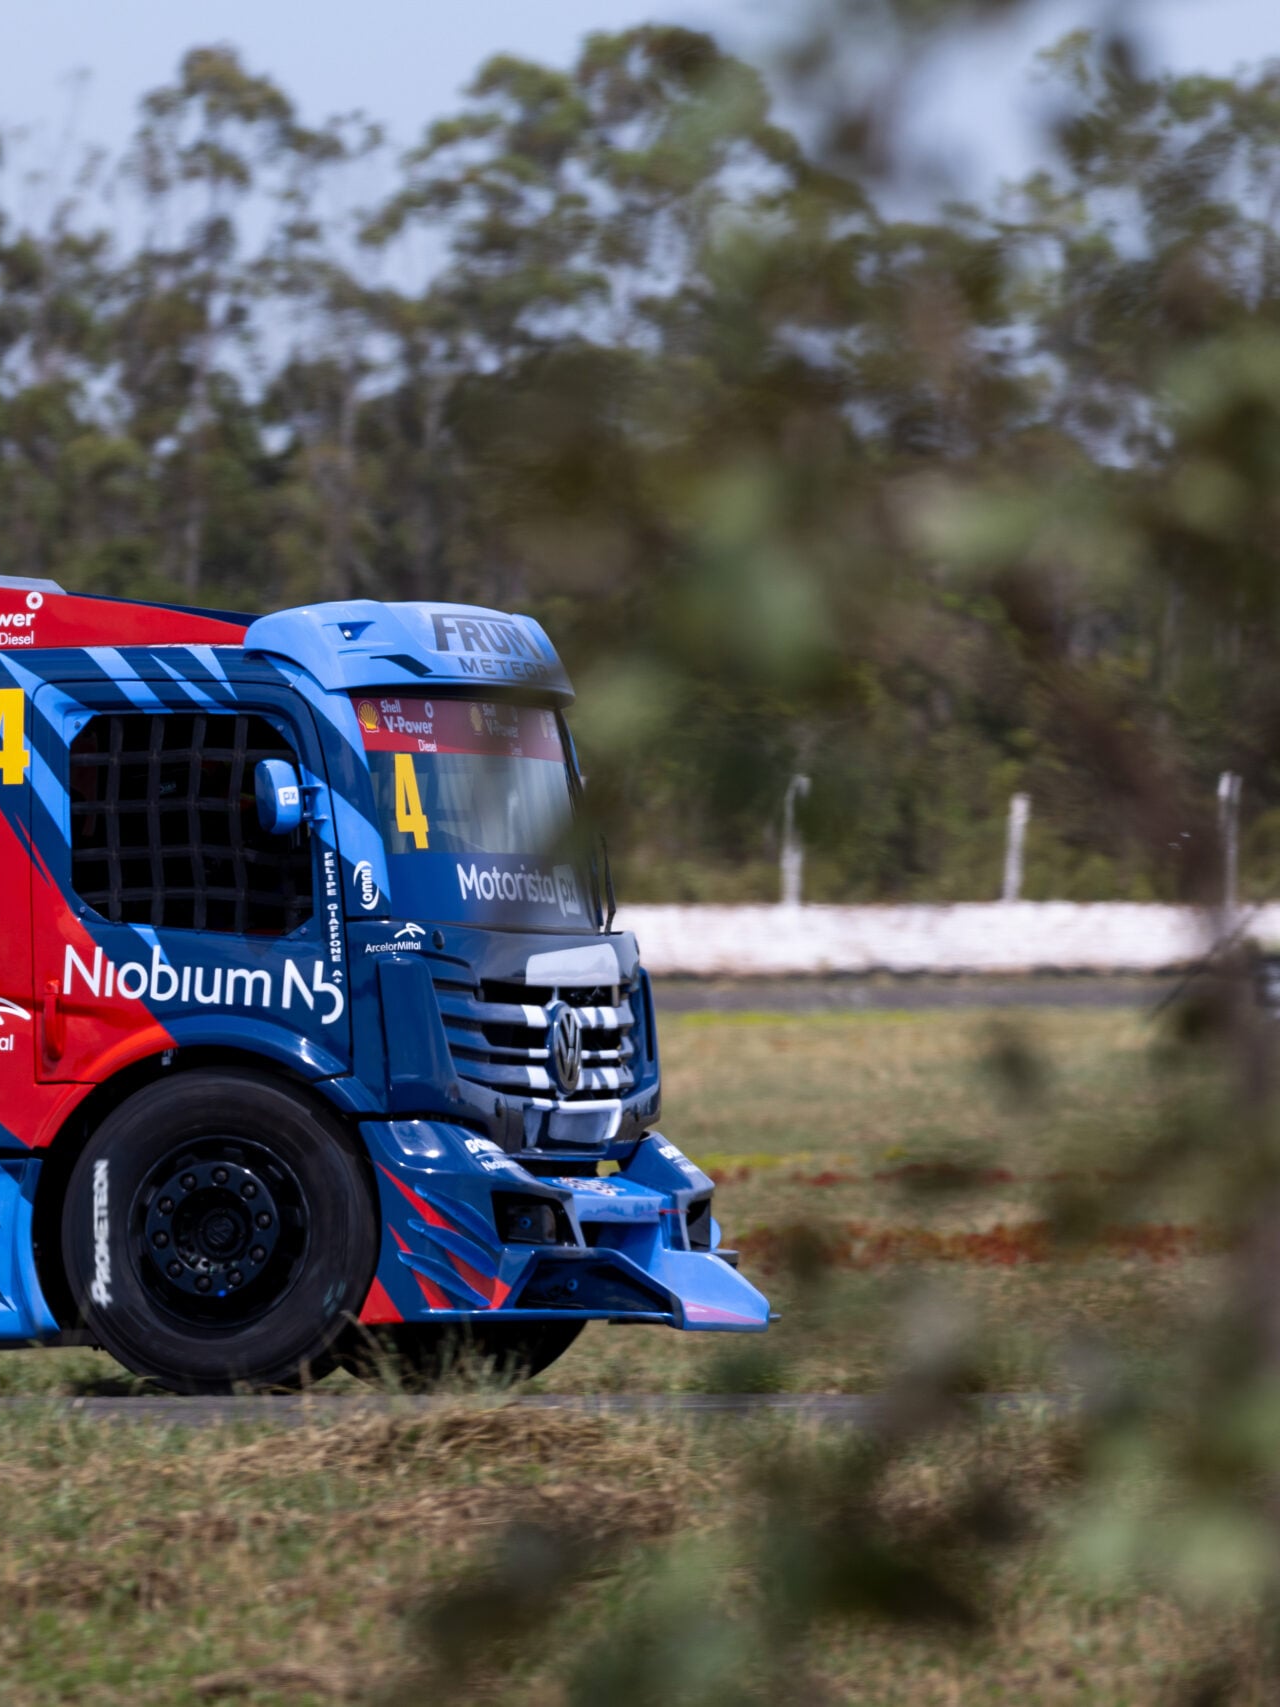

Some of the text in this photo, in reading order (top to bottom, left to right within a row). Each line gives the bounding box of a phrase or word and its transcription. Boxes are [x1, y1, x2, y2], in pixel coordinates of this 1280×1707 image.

[380, 699, 402, 713] Shell
[383, 715, 433, 734] V-Power
[418, 738, 437, 752] Diesel
[394, 753, 429, 849] 4
[457, 863, 556, 904] Motorista
[324, 852, 343, 984] FELIPE GIAFFONE A+
[365, 940, 421, 954] ArcelorMittal
[63, 945, 271, 1008] Niobium
